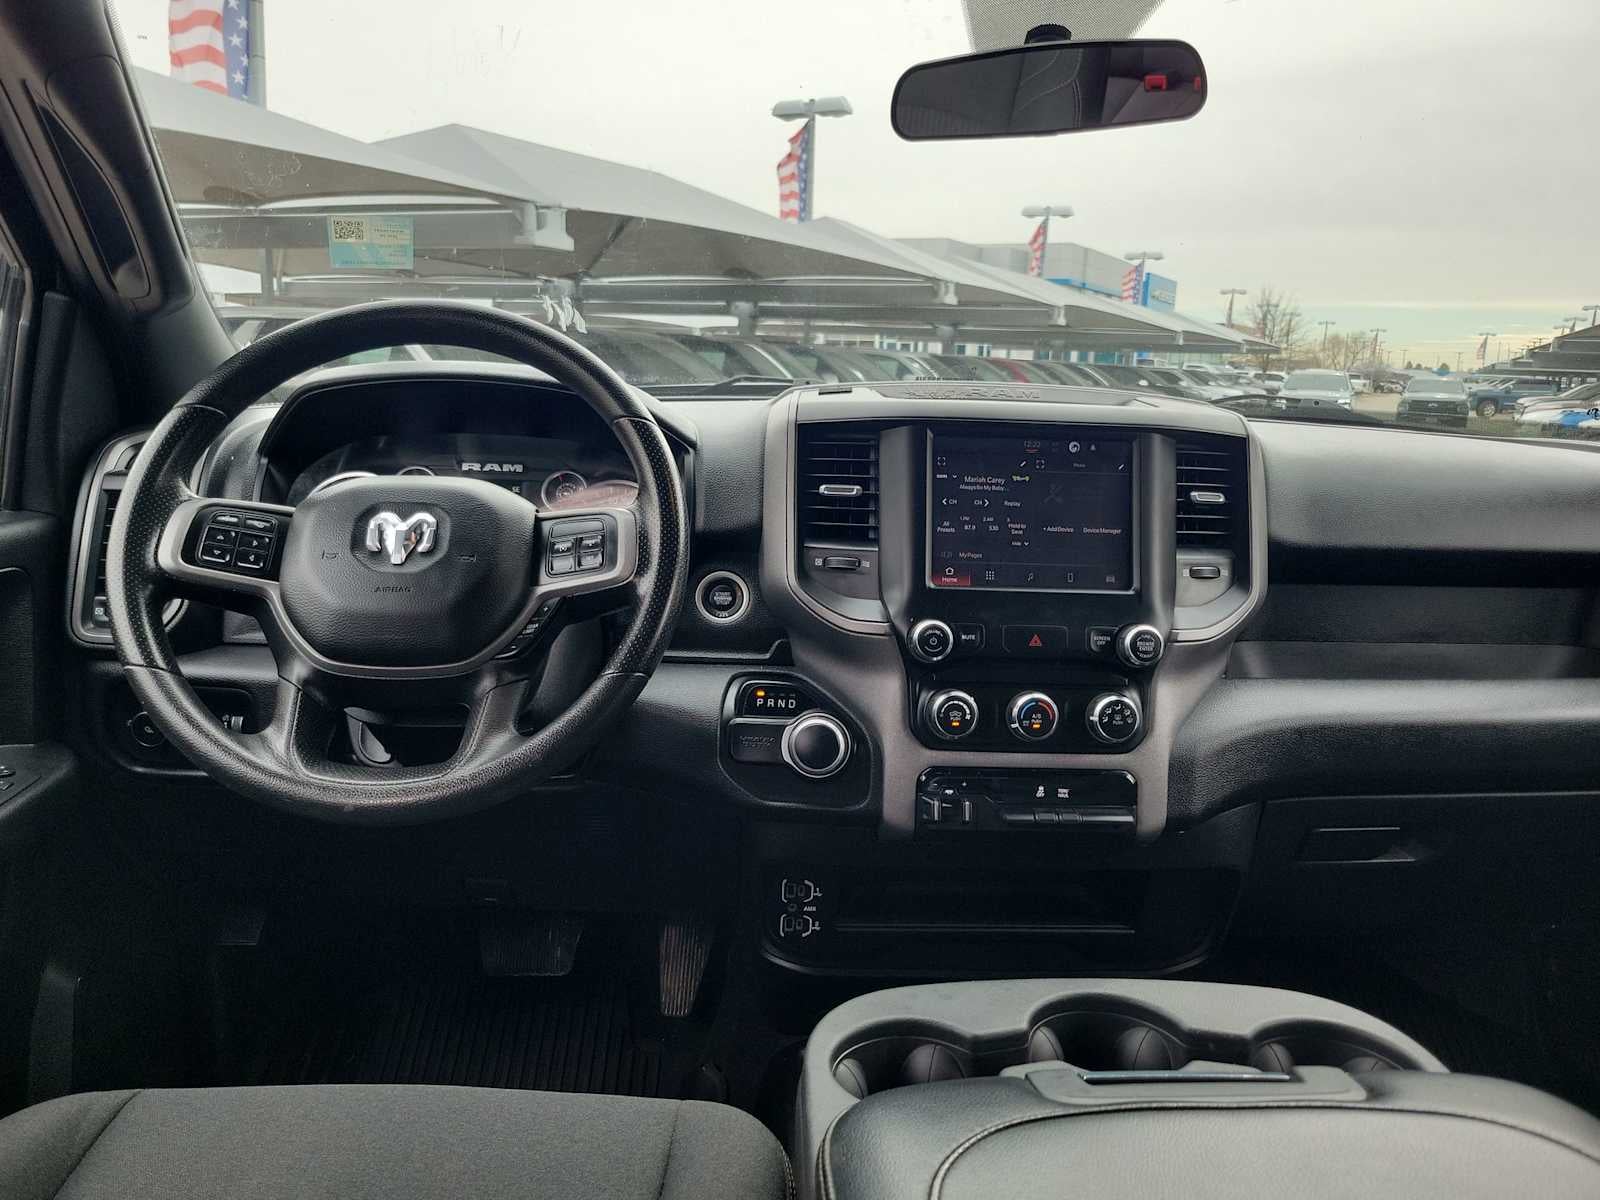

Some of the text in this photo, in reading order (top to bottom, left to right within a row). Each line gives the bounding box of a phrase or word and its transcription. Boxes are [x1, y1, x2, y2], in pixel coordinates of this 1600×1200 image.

[461, 462, 524, 473] RAM
[964, 475, 1005, 486] Mariah Carey
[374, 585, 411, 593] AIRBAG
